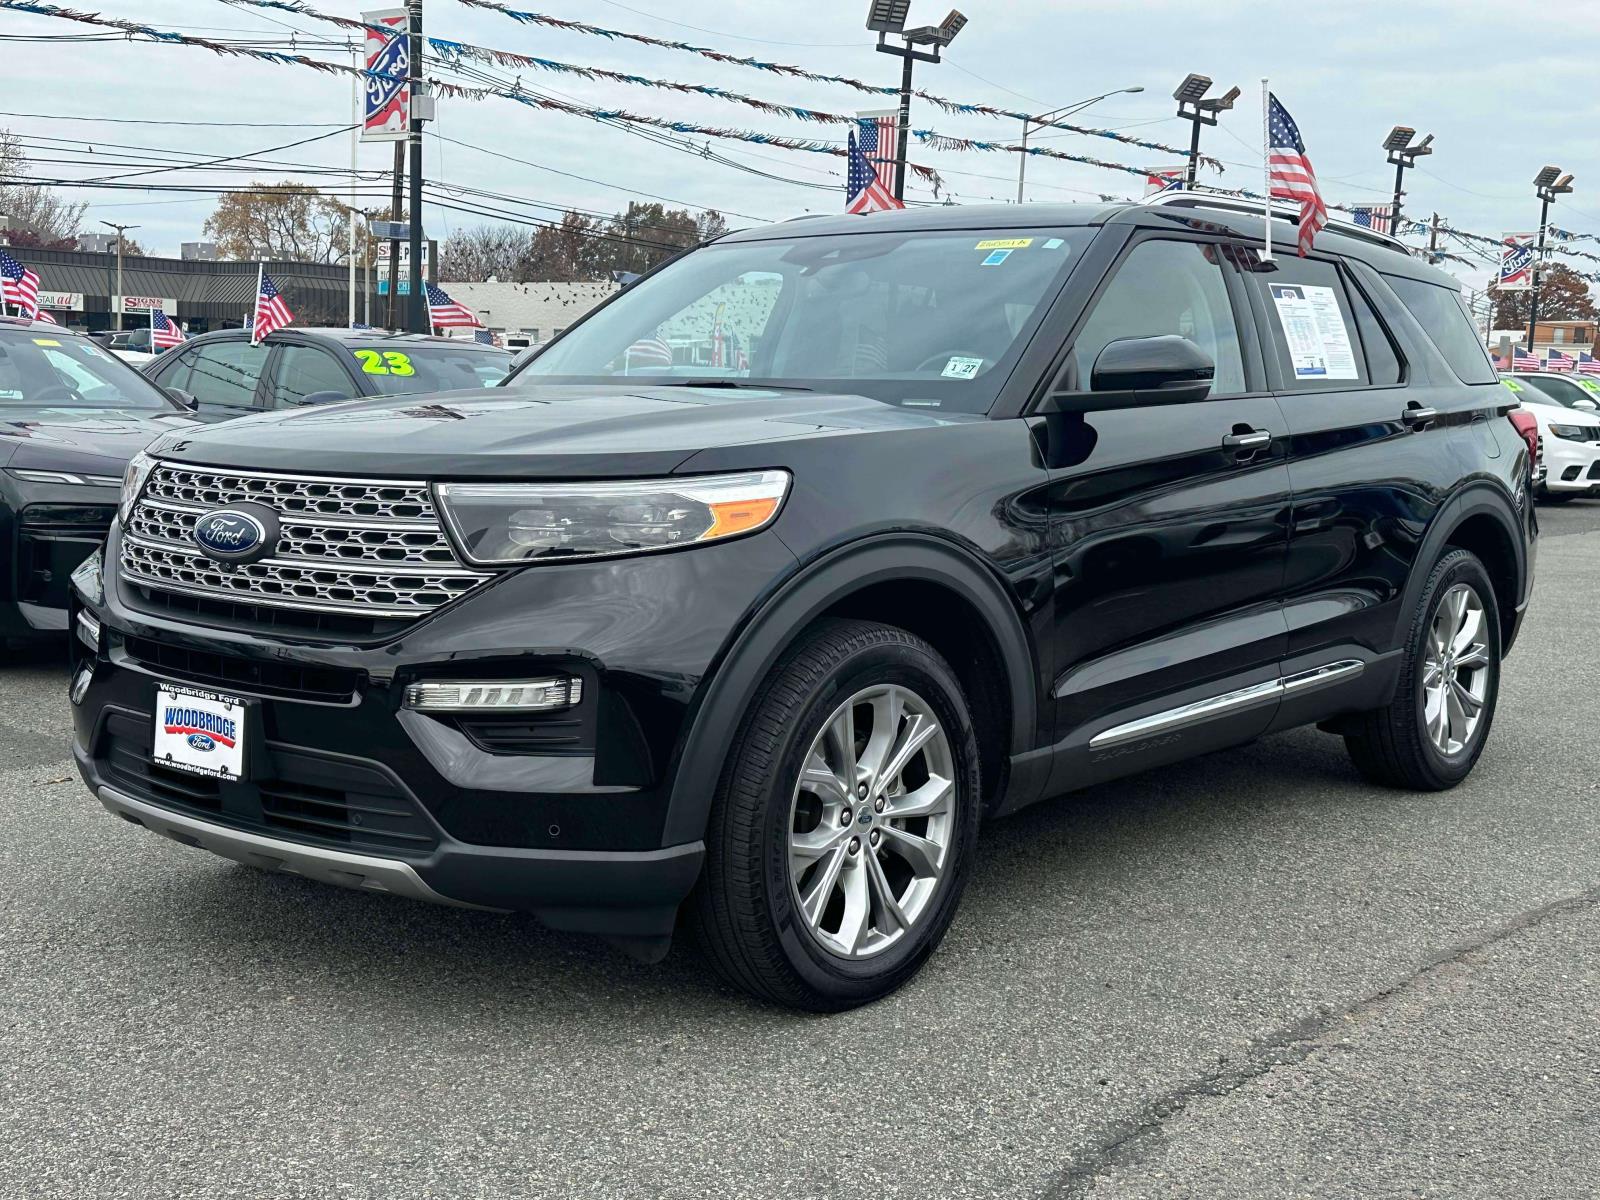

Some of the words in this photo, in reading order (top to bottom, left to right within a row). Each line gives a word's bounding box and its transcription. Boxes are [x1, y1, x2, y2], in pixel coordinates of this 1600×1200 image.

[366, 43, 409, 105] Ford
[1502, 248, 1532, 274] Ford
[124, 297, 163, 307] SIGNS
[353, 349, 415, 377] 23
[962, 364, 977, 373] 27
[205, 518, 246, 545] Ford
[160, 683, 216, 700] Woodbridge
[218, 694, 240, 705] Ford
[164, 706, 237, 740] WOODBRIDGE
[191, 735, 212, 749] Ford
[154, 758, 238, 781] www.woodbridgeford.com
